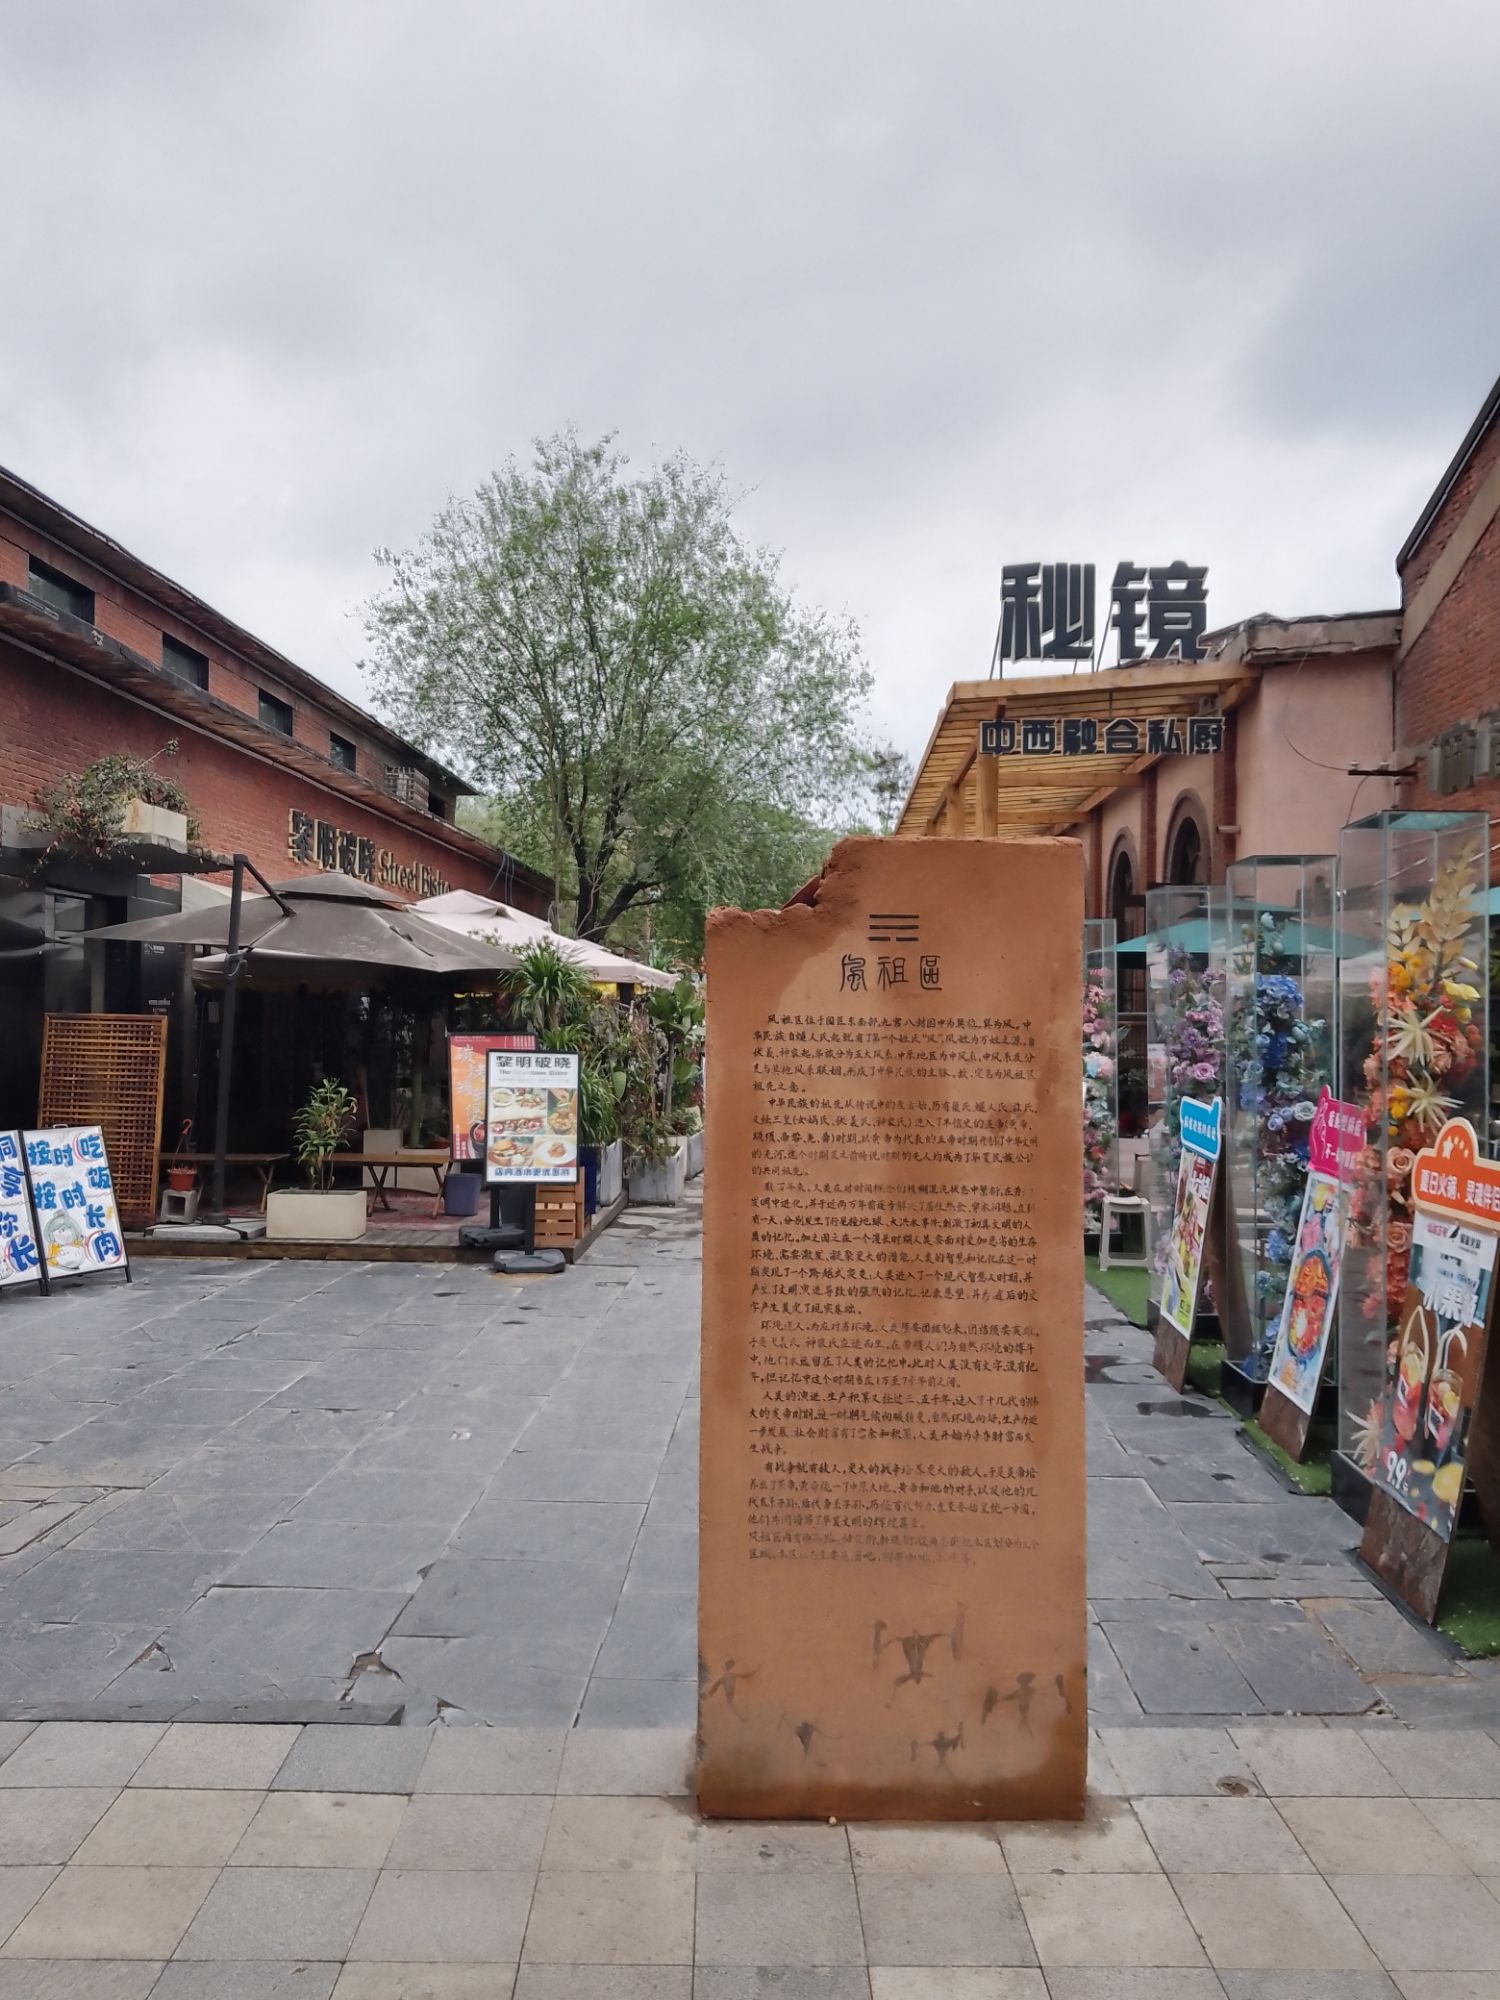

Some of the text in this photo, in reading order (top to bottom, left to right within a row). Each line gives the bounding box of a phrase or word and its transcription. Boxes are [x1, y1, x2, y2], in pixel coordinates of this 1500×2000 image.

[1000, 560, 1210, 662] 秘镜
[980, 716, 1225, 756] 中西融合私厨
[378, 847, 419, 893] Street
[496, 1055, 571, 1069] 黎明破晓
[27, 1139, 74, 1167] 按时
[34, 1180, 87, 1211] 按时
